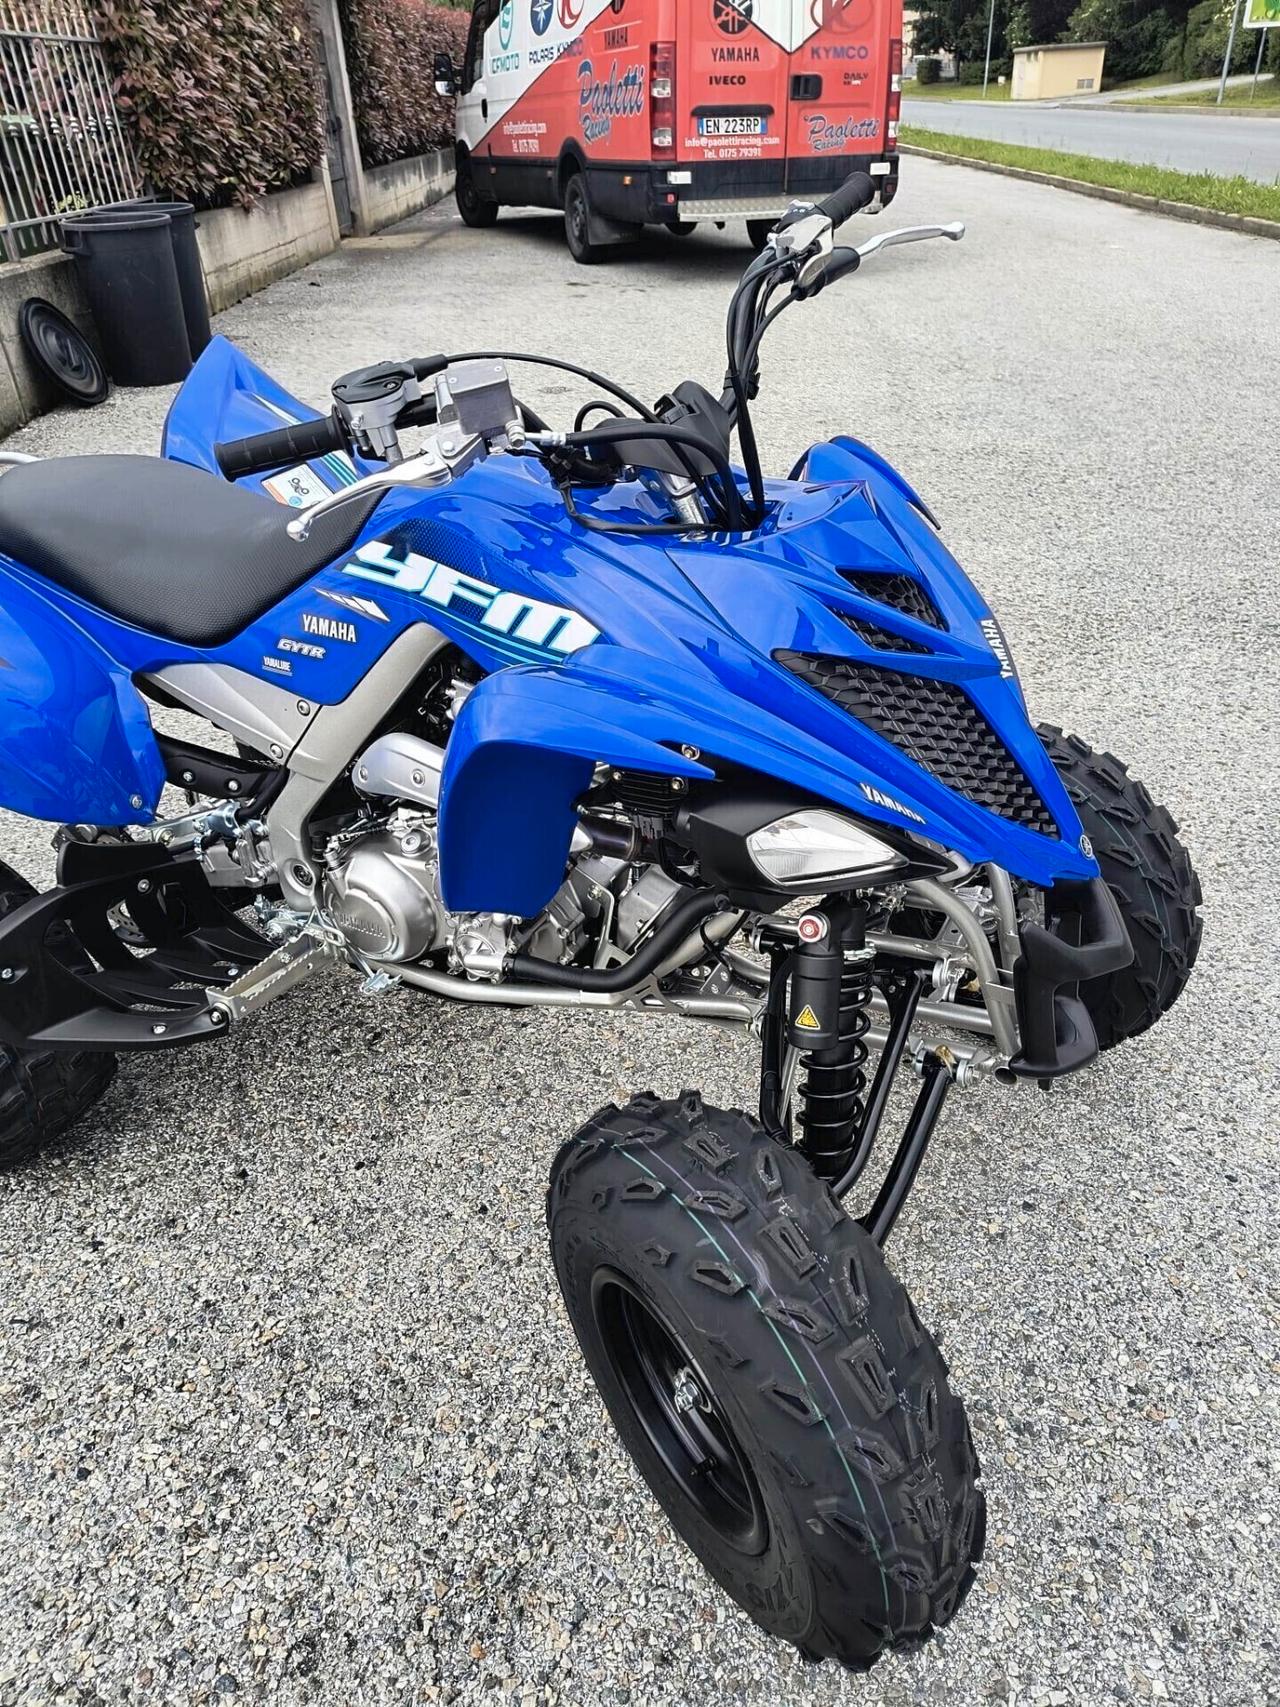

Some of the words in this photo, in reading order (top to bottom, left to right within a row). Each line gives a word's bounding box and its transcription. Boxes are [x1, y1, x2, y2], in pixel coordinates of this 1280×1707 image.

[529, 45, 555, 64] POLARIS
[711, 47, 760, 62] YAMAHA
[811, 46, 868, 60] KYMCO
[491, 53, 519, 74] CFMOTO
[709, 75, 746, 86] IVECO
[843, 72, 868, 81] DAILY
[577, 58, 645, 117] Paoletti
[705, 119, 720, 134] EN
[724, 118, 760, 134] 223RP
[804, 114, 879, 140] Paoletti
[684, 136, 780, 149] info@paolettiracing.com
[719, 148, 737, 158] 0175
[302, 613, 357, 643] YAMAHA
[277, 638, 326, 659] GYTR
[981, 619, 1013, 679] YAMAHA
[263, 656, 291, 672] YAMALUBE
